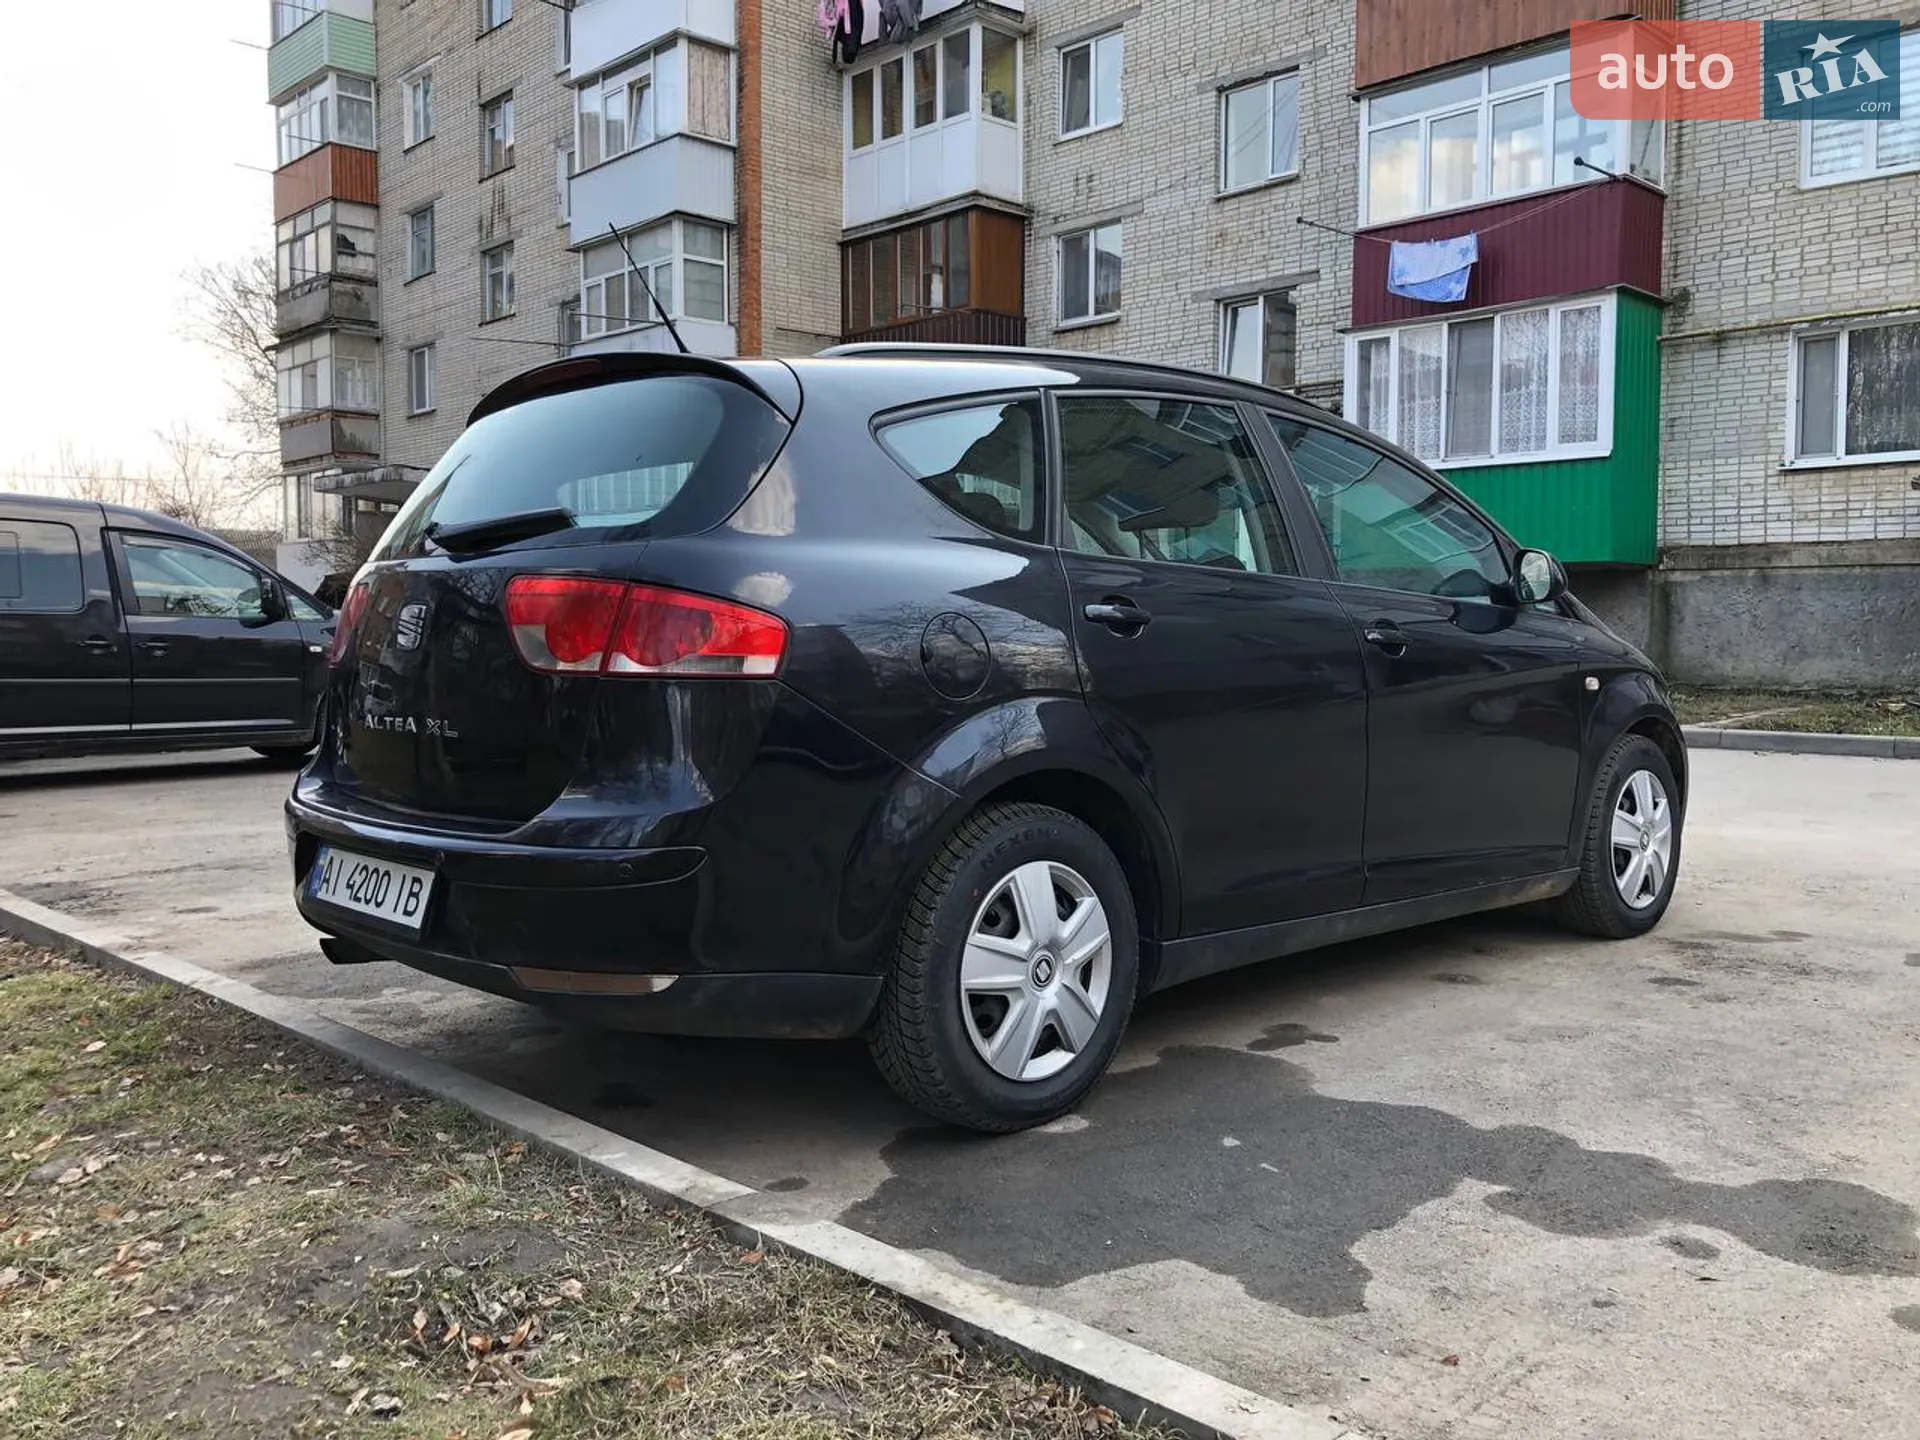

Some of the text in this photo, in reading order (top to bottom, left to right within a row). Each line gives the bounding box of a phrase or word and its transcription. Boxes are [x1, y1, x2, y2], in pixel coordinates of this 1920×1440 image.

[364, 714, 459, 738] ALTEA XL
[981, 827, 1051, 872] NEXEN
[320, 856, 423, 917] AI 4200 IB
